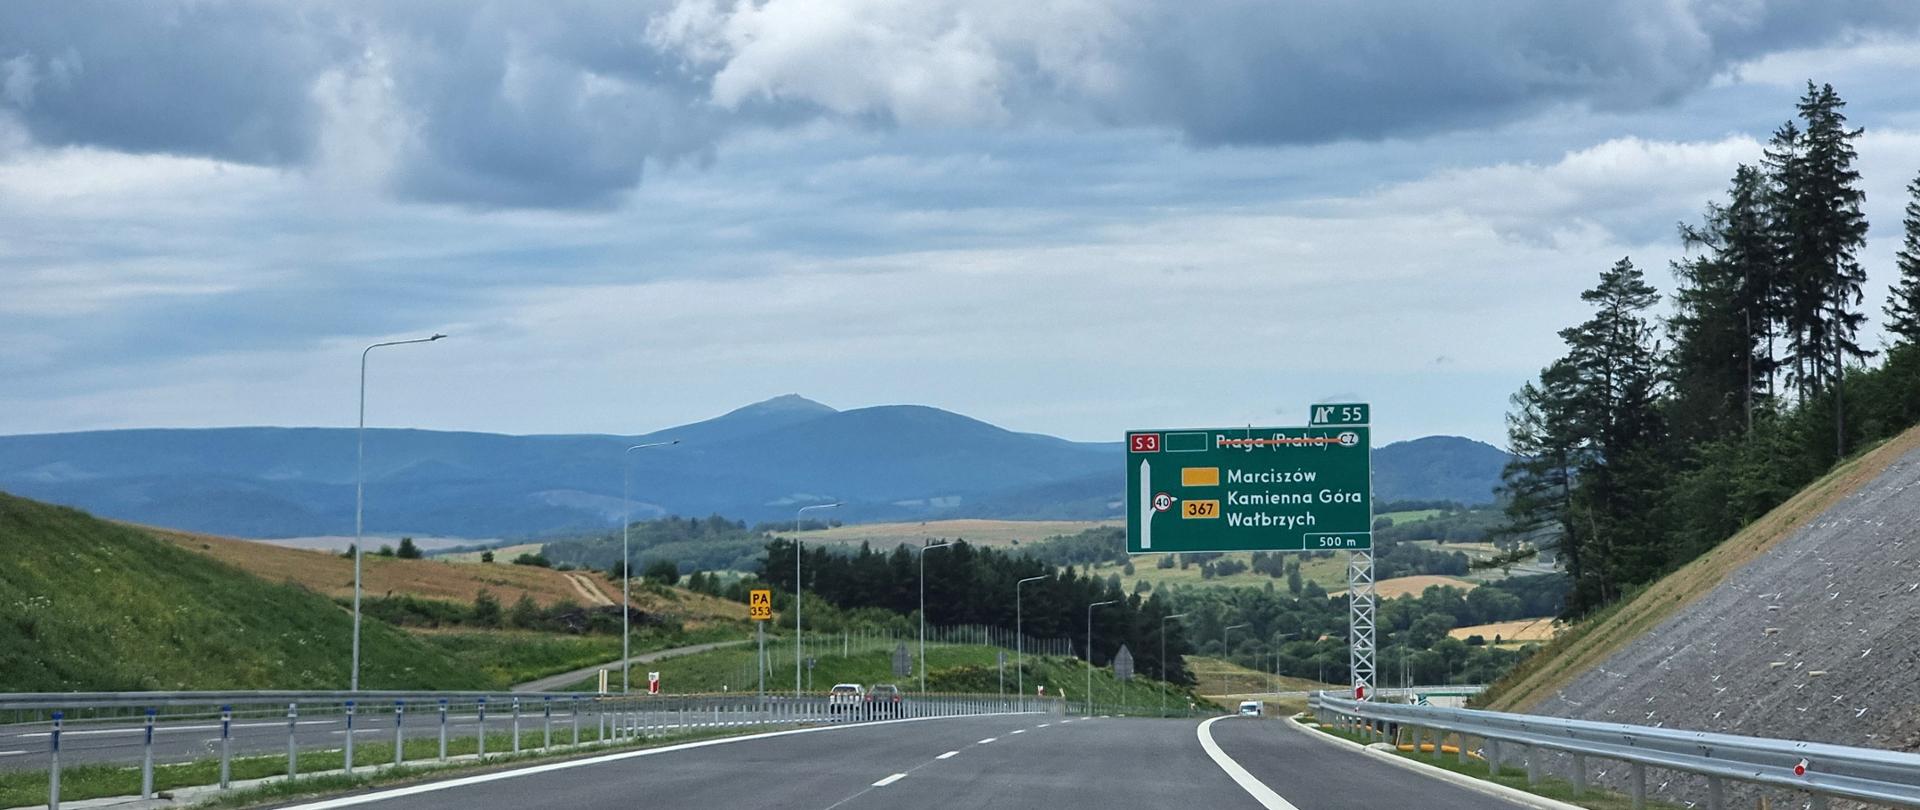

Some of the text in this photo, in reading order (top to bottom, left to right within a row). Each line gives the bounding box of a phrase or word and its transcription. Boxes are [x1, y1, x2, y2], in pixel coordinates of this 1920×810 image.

[1342, 407, 1362, 421] 55
[1216, 432, 1355, 451] Praga (Praha) CZ
[1227, 468, 1317, 483] Marciszów
[1156, 498, 1169, 507] 40
[1227, 489, 1362, 505] Kamienna Góra
[1188, 503, 1213, 515] 367
[1227, 512, 1316, 530] Wałbrzych
[1319, 536, 1356, 547] 500 m
[753, 593, 768, 604] PA
[751, 606, 771, 616] 353
